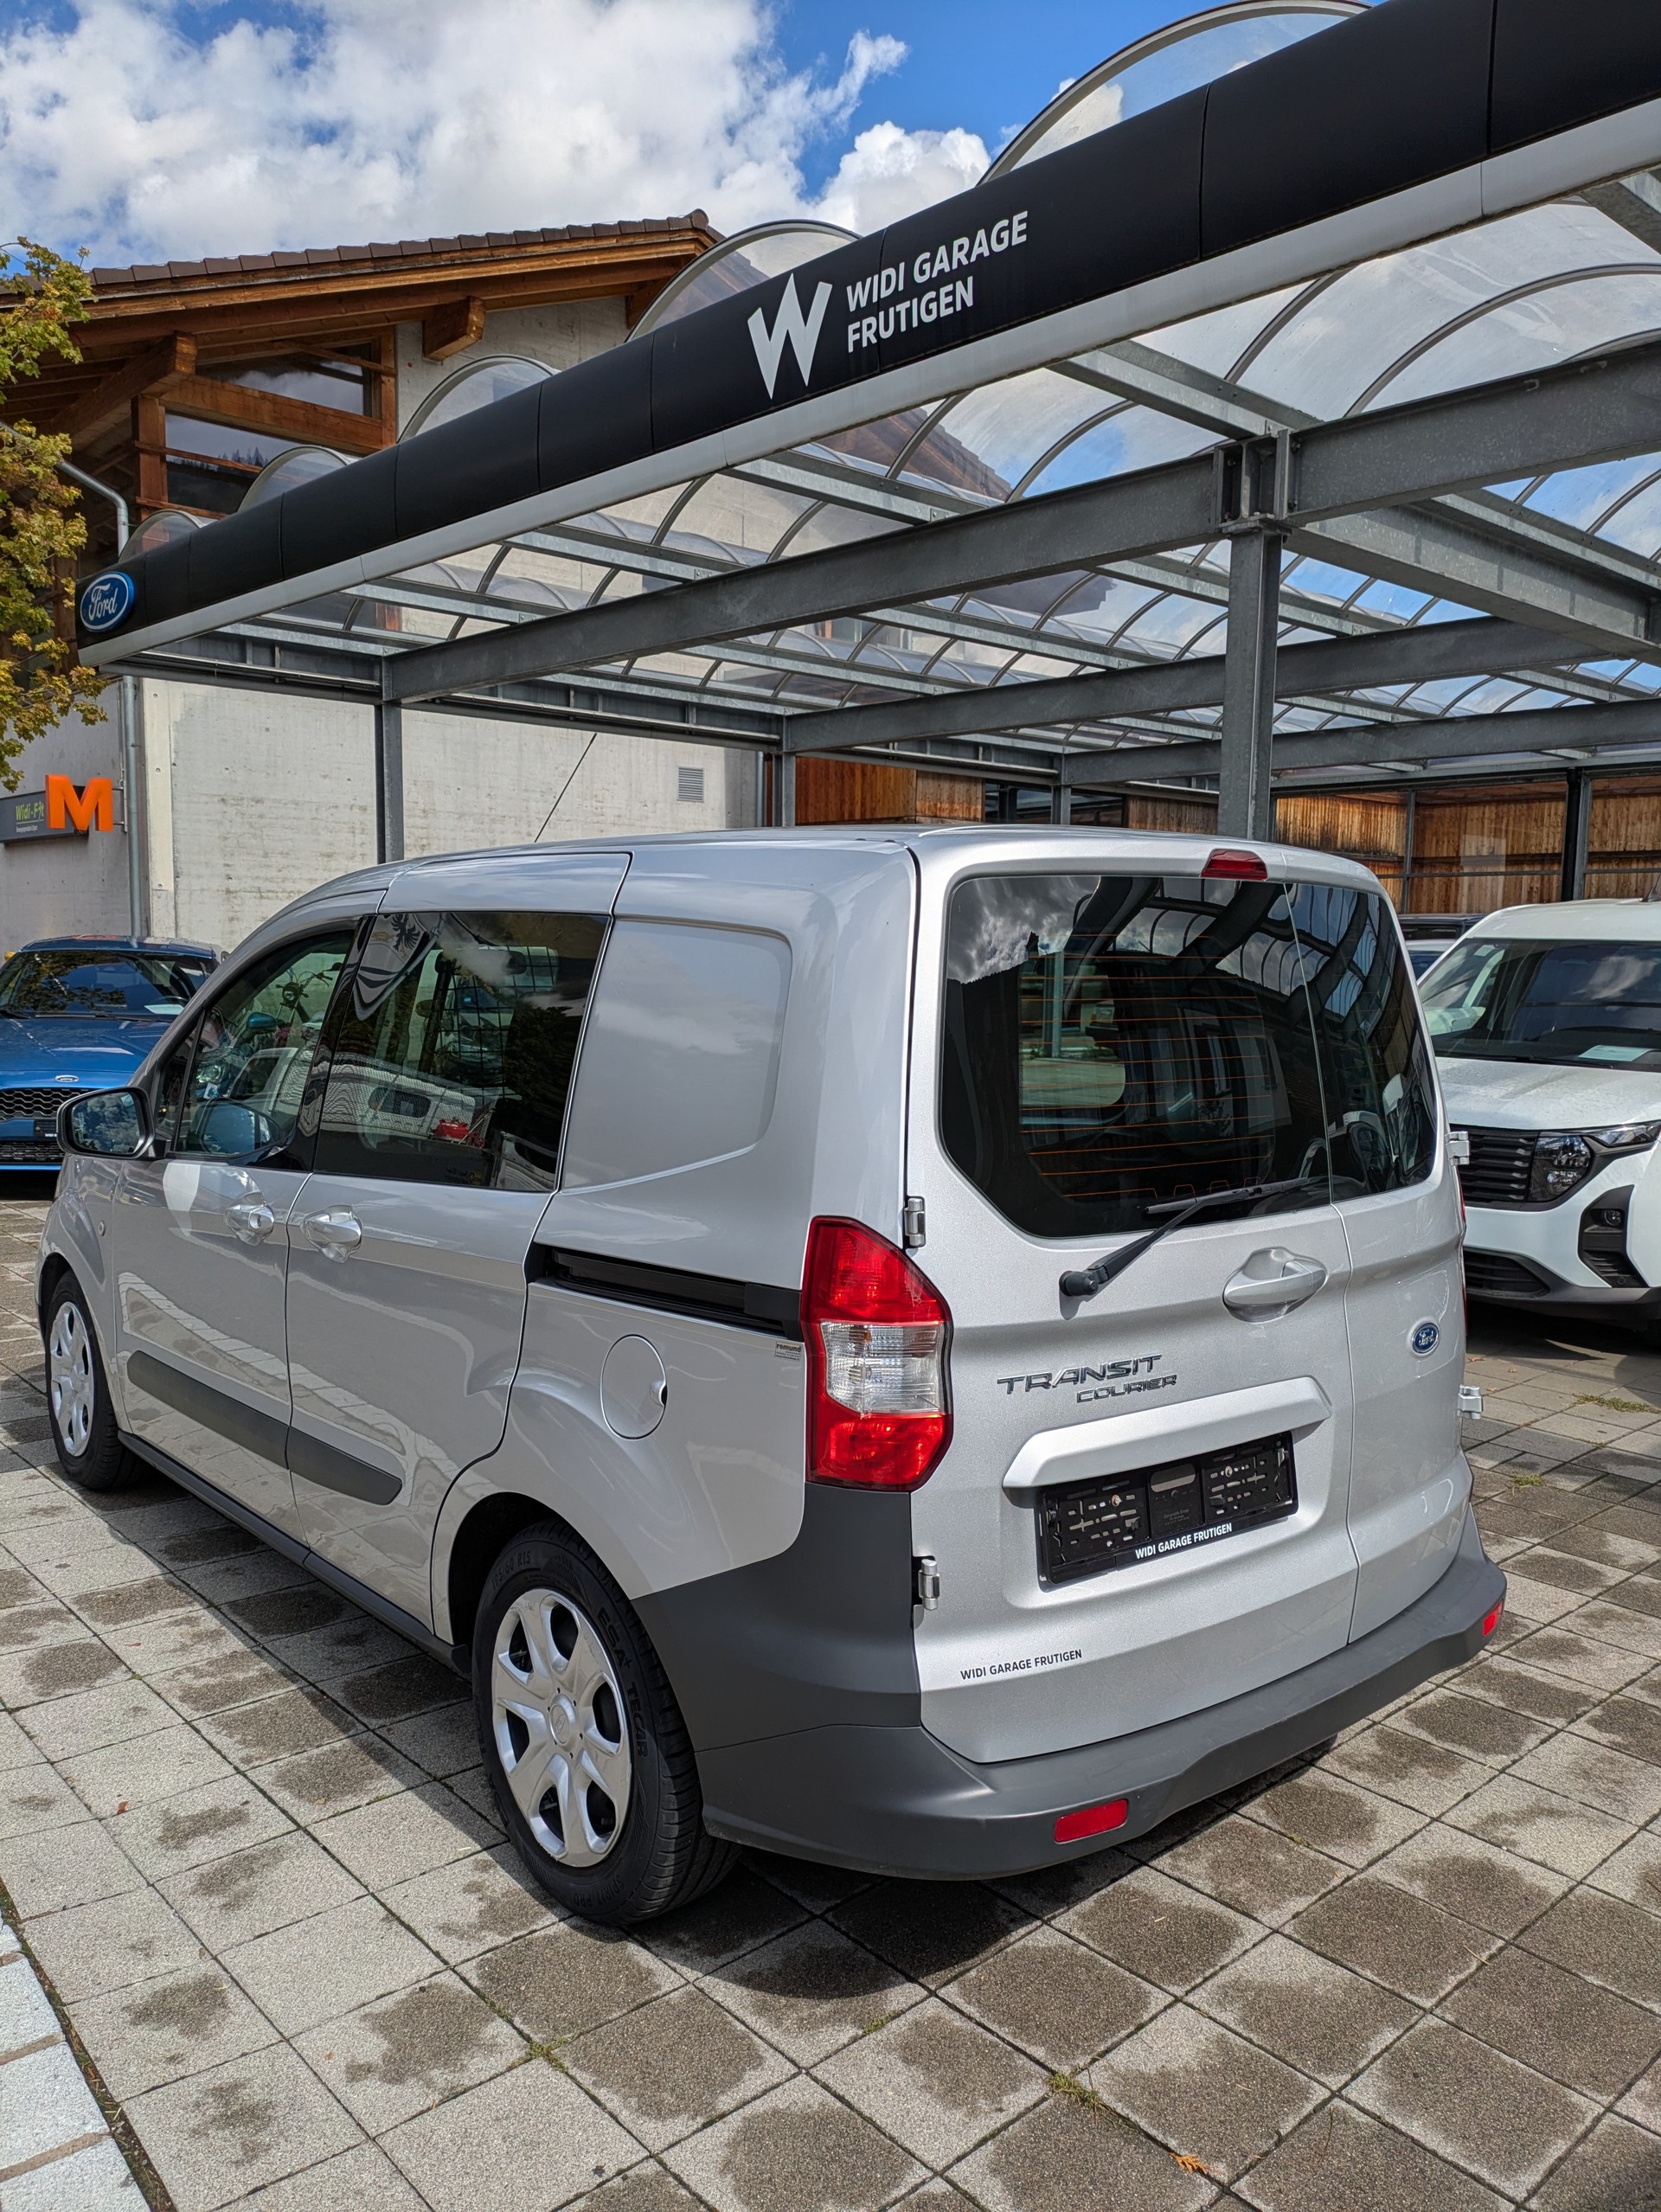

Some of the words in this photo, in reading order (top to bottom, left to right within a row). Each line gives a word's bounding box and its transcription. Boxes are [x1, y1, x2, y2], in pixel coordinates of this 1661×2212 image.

[846, 261, 905, 312] WIDI
[913, 210, 1028, 284] GARAGE
[847, 276, 974, 353] FRUTIGEN
[88, 582, 119, 621] Ford
[45, 774, 113, 831] M
[776, 1343, 801, 1352] remund
[997, 1354, 1163, 1395] TRANSIT
[1077, 1374, 1177, 1403] COURIER
[1135, 1546, 1157, 1560] WIDI
[1158, 1535, 1192, 1553] GARAGE
[1193, 1523, 1233, 1543] FRUTIGEN
[960, 1666, 987, 1680] WIDI
[990, 1658, 1032, 1675] GARAGE
[1034, 1649, 1082, 1667] FRUTIGEN
[626, 1681, 648, 1758] TECAR
